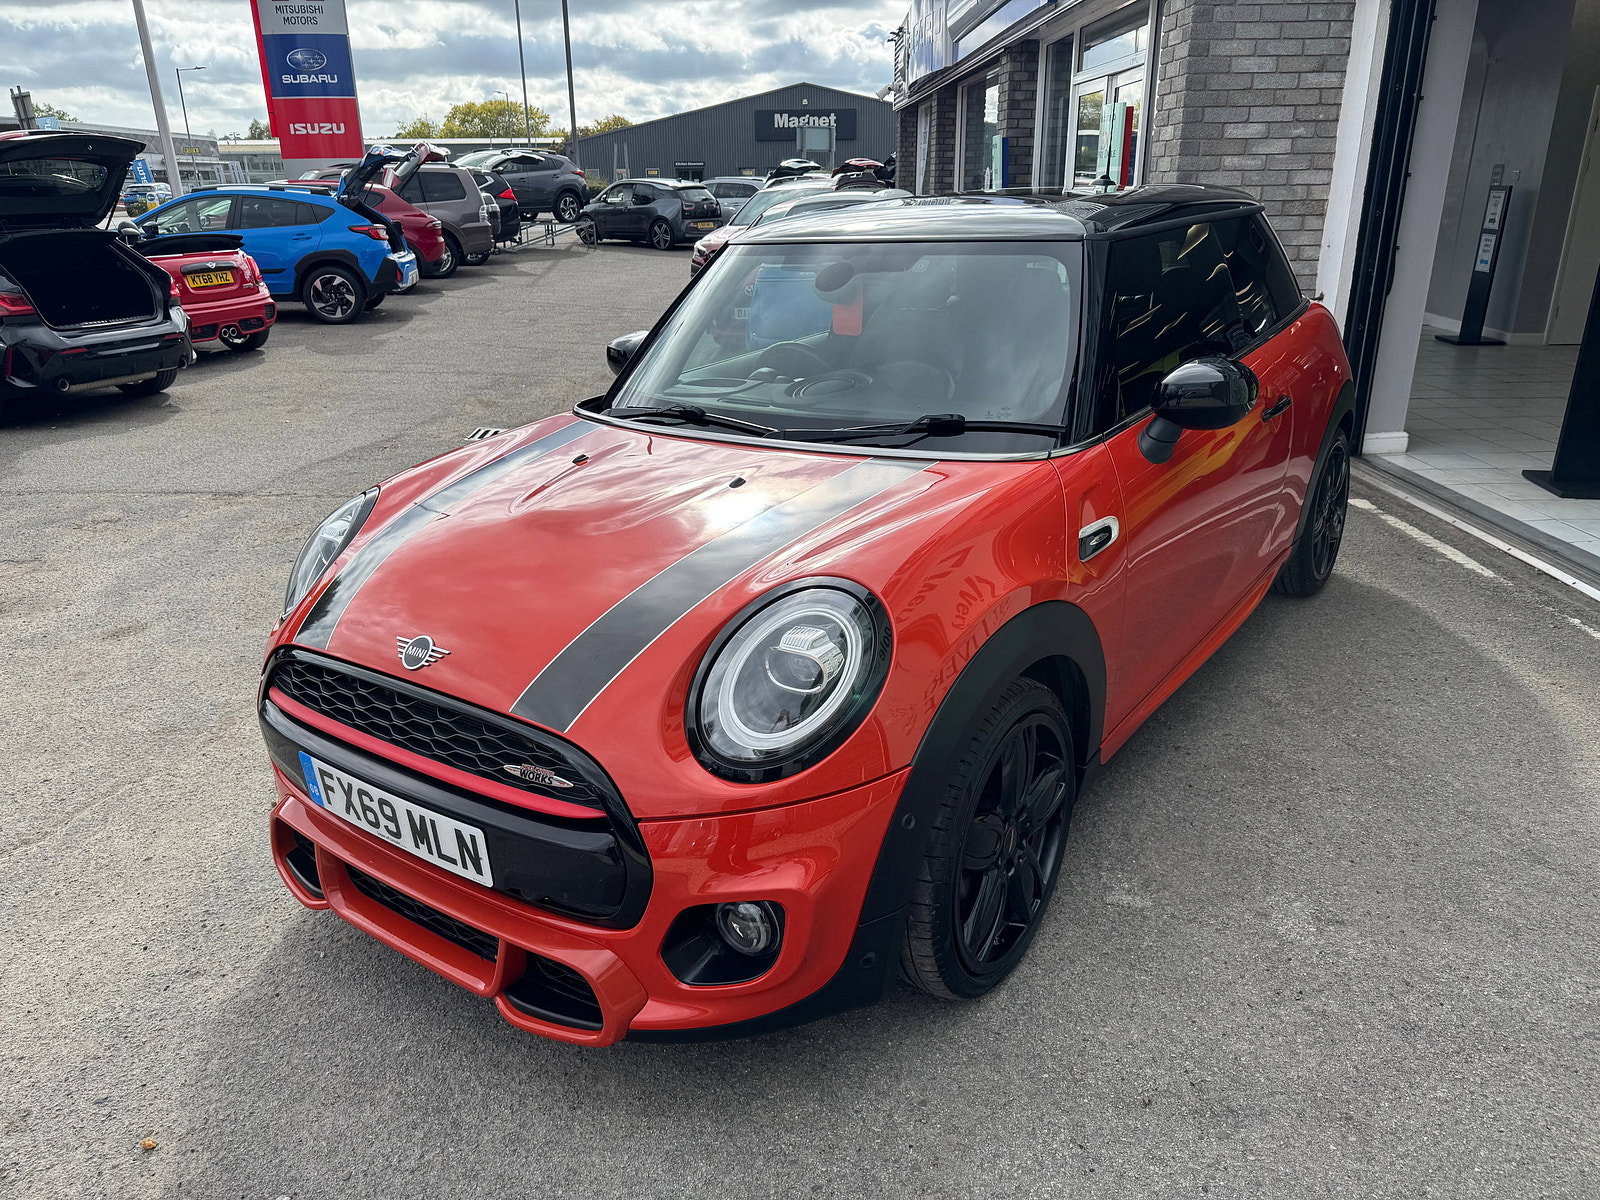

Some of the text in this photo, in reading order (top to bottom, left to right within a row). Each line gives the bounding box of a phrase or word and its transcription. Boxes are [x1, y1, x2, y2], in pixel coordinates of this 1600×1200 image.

[275, 5, 324, 14] MITSUBISHI
[283, 16, 318, 25] MOTORS
[282, 74, 338, 84] SUBARU
[774, 113, 837, 128] Magnet
[289, 123, 346, 135] ISUZU
[213, 272, 230, 283] YHZ
[406, 645, 427, 659] MINI
[520, 769, 554, 785] WORKS
[309, 782, 320, 796] GB
[317, 766, 484, 877] FX69 MLN
